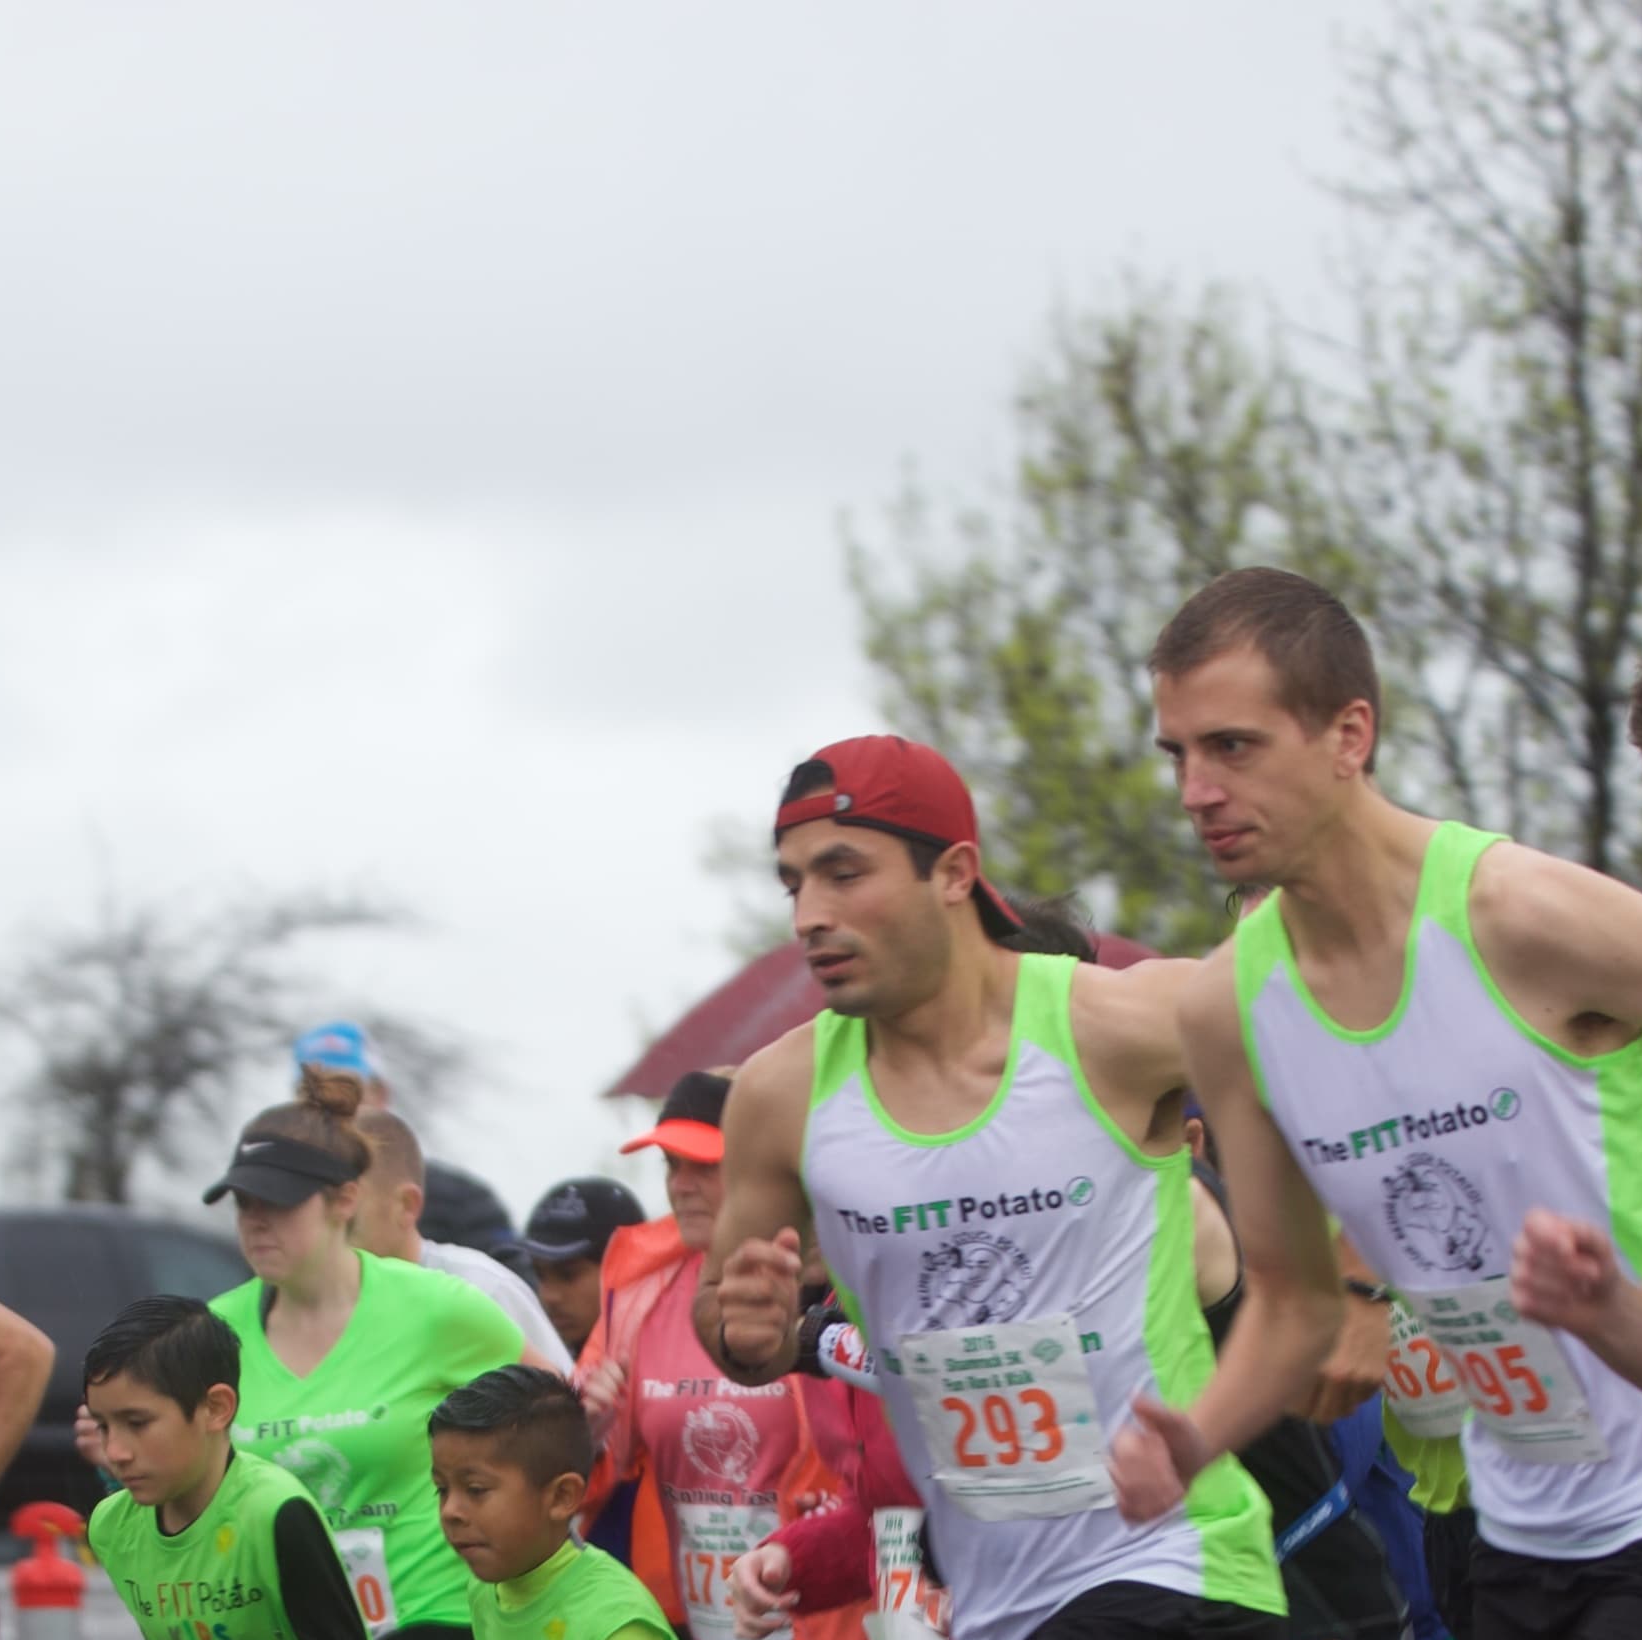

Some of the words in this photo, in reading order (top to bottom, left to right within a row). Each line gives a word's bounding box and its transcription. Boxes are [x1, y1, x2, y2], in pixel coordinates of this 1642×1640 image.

[1302, 1138, 1348, 1163] The
[1348, 1118, 1402, 1159] FIT
[1403, 1103, 1489, 1142] Potato
[837, 1209, 889, 1234] The
[891, 1199, 953, 1234] FIT
[959, 1188, 1063, 1223] Potato
[643, 1379, 675, 1398] The
[677, 1379, 714, 1396] FIT
[258, 1419, 295, 1439] FIT
[941, 1388, 1064, 1468] 293
[157, 1581, 193, 1617] FIT
[197, 1576, 263, 1616] Potato
